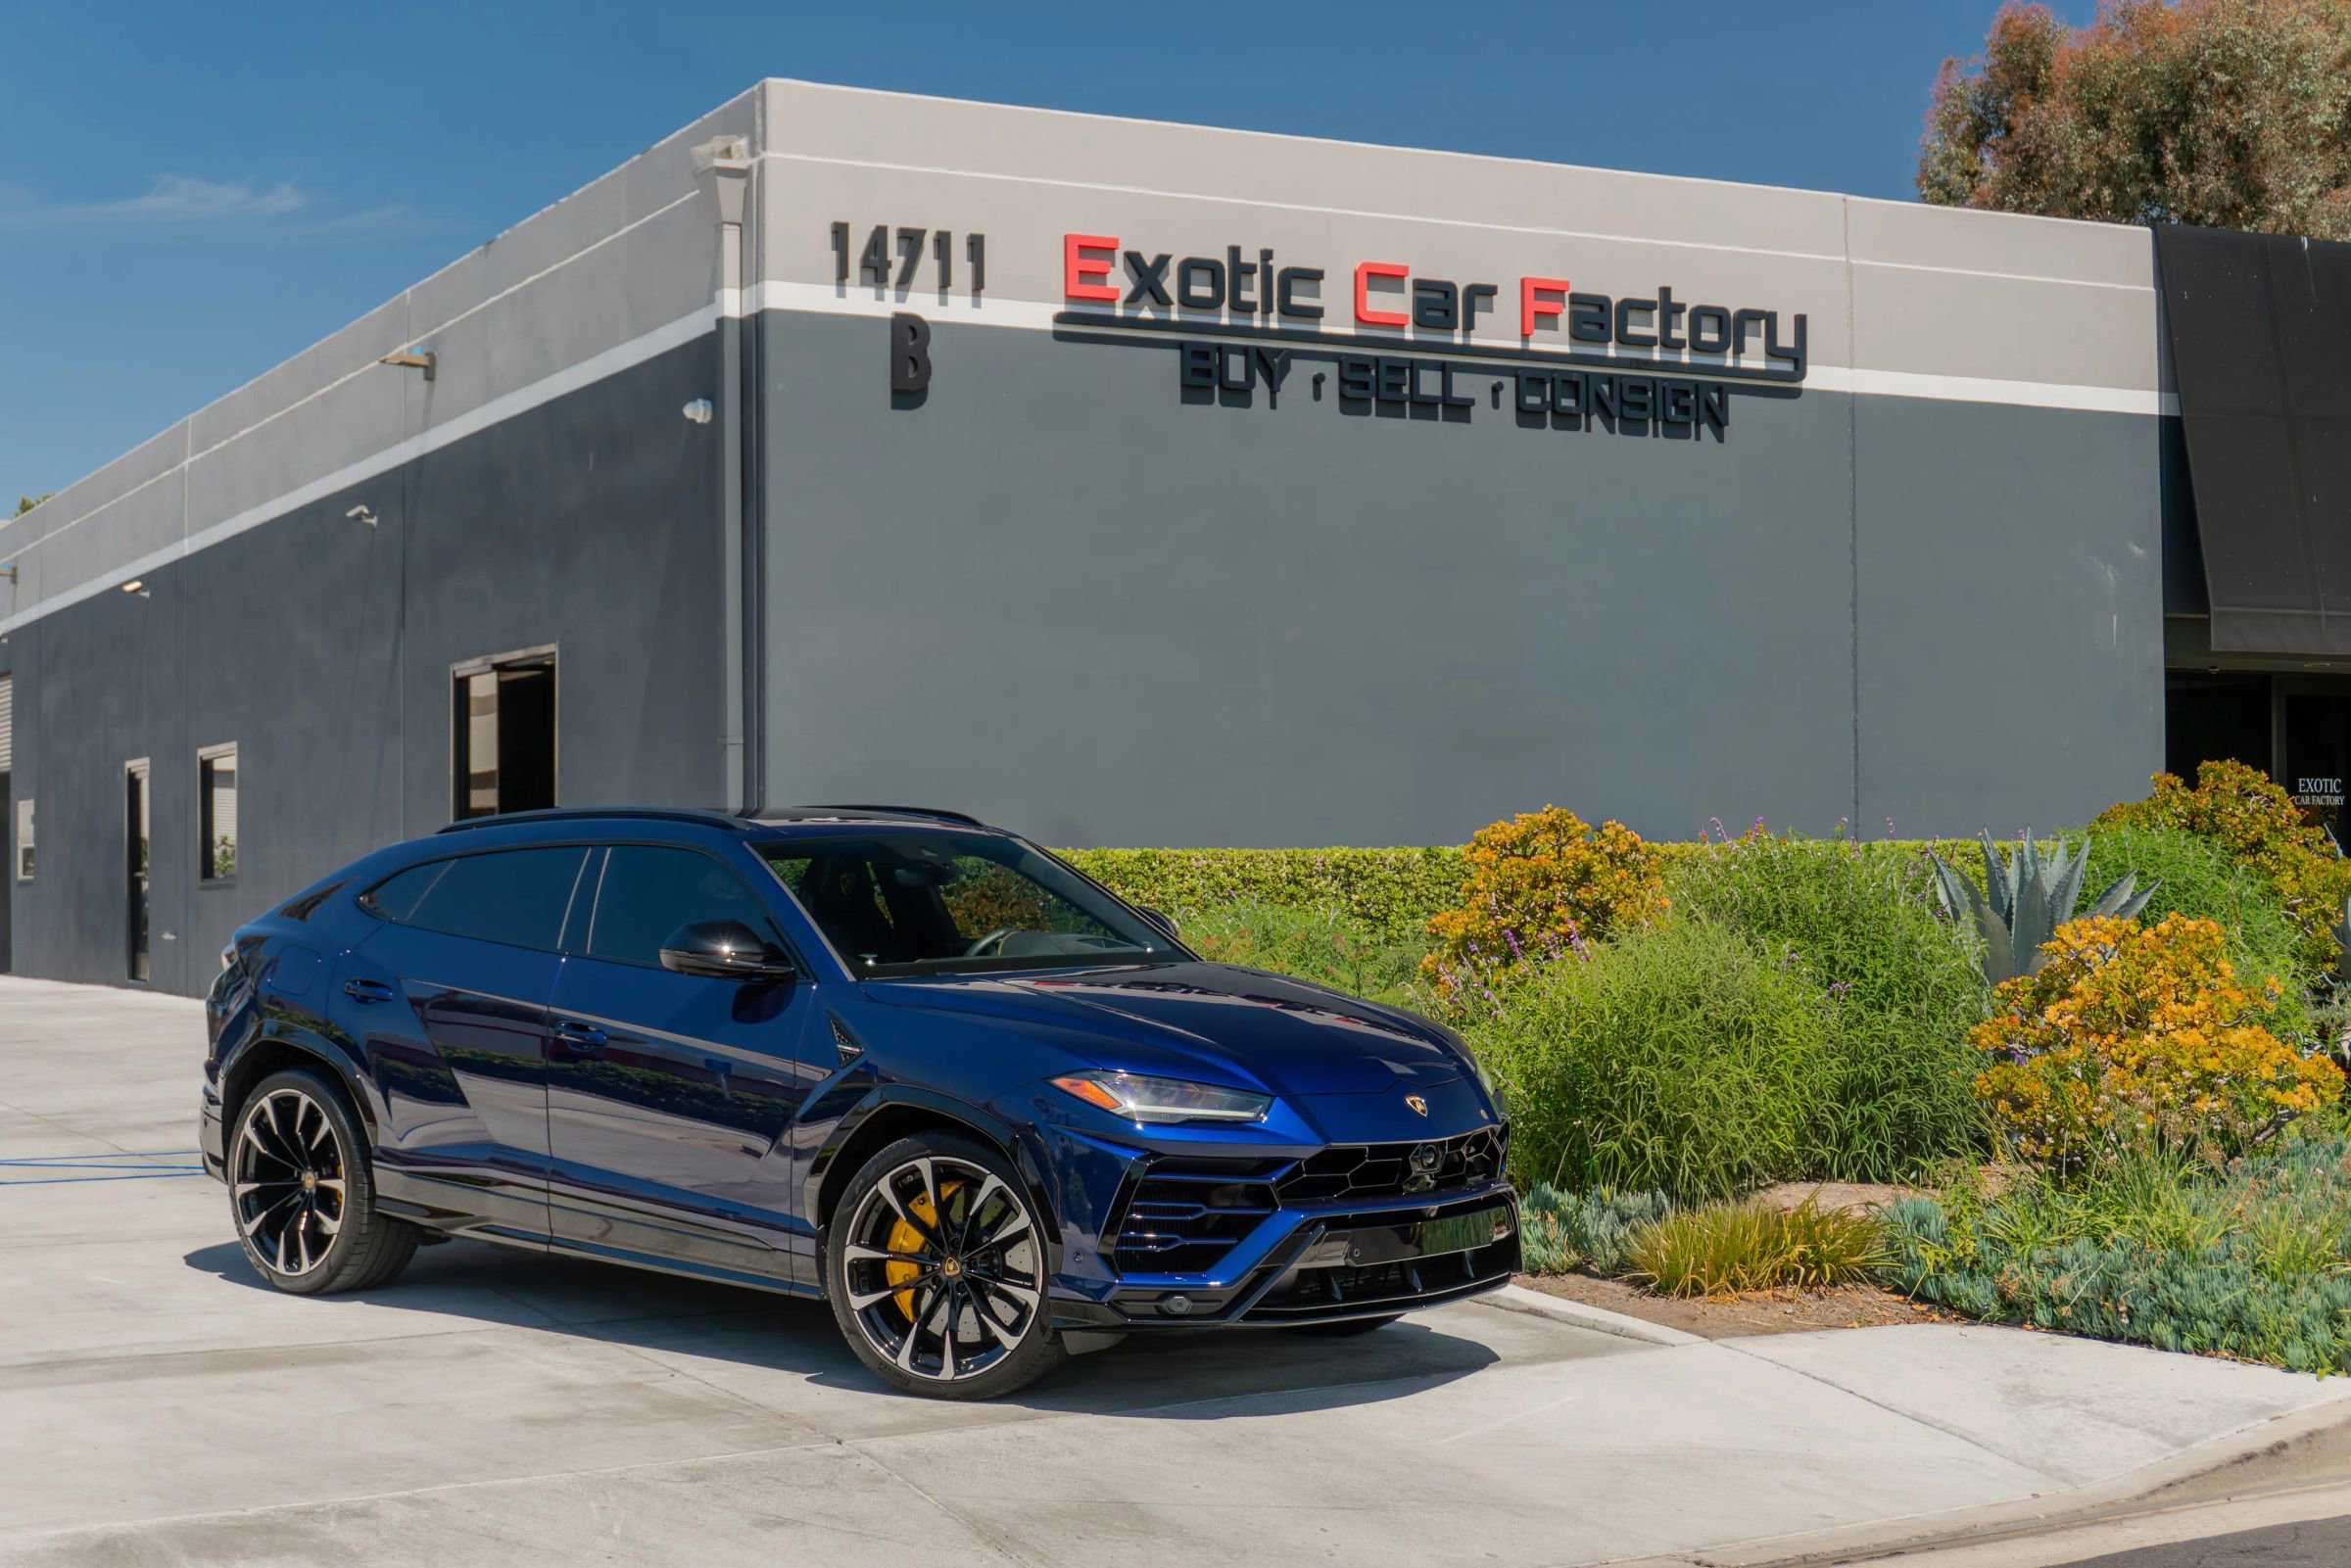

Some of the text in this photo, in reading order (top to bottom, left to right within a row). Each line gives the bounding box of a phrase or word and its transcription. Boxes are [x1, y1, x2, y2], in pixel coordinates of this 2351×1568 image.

[832, 221, 985, 290] 14711
[1064, 233, 1808, 381] Exotic Car Factory
[890, 312, 933, 392] B
[1179, 343, 1730, 426] BUY SELL CONSIGN
[2294, 795, 2345, 805] CAR FACTORY
[2298, 778, 2342, 793] EXOTIC
